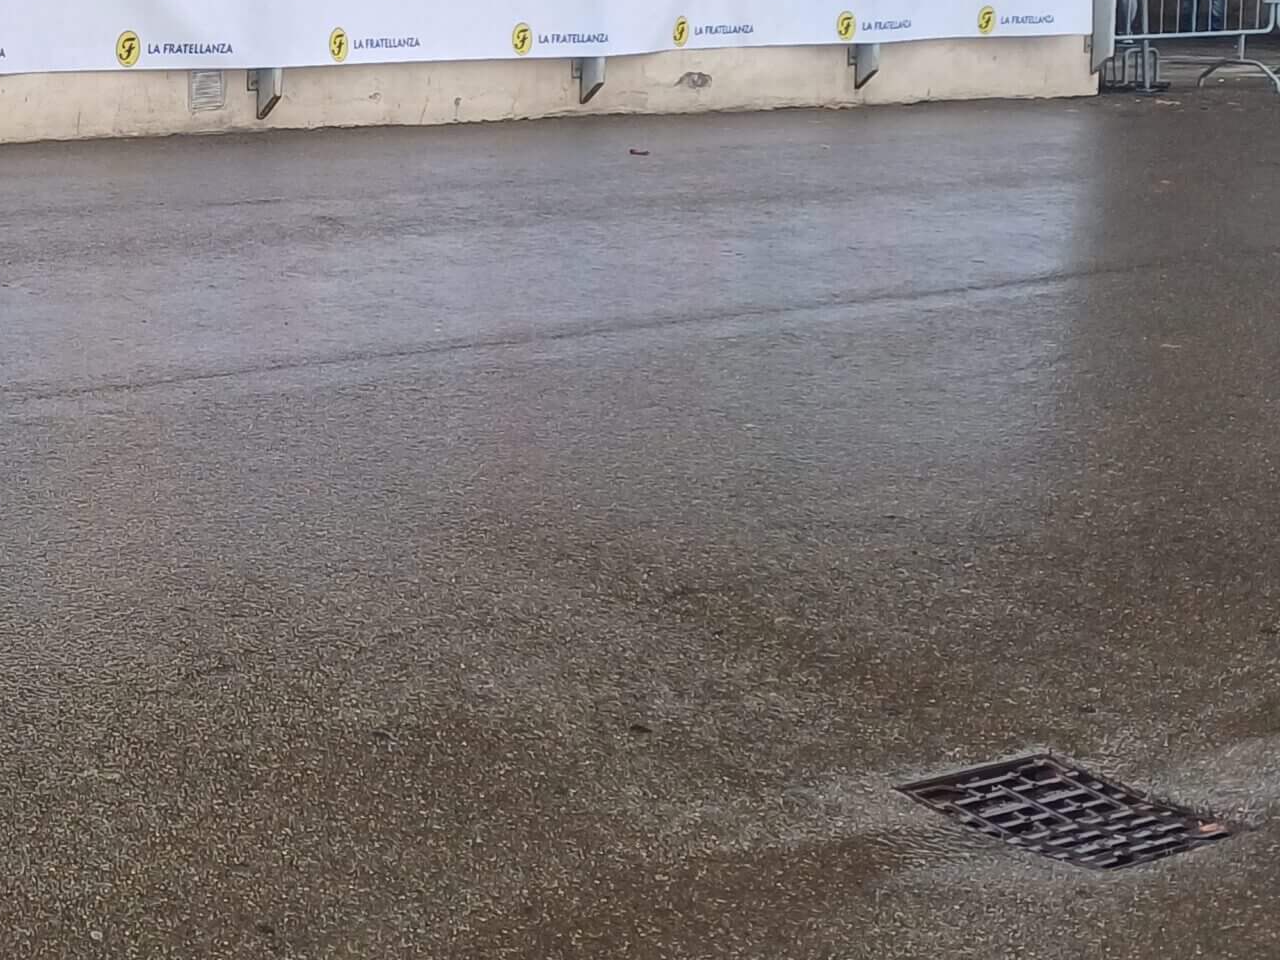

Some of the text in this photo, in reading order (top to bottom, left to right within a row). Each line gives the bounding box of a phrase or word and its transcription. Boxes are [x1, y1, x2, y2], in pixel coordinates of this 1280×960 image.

[1000, 15, 1010, 25] LA
[694, 26, 704, 36] LA
[705, 24, 754, 35] FRATELLANZA
[862, 21, 872, 31] LA
[353, 39, 365, 50] LA
[366, 37, 421, 50] FRATELLANZA
[538, 33, 549, 44] LA
[551, 33, 610, 44] FRATELLANZA
[147, 43, 161, 55] LA
[163, 43, 233, 55] FRATELLANZA
